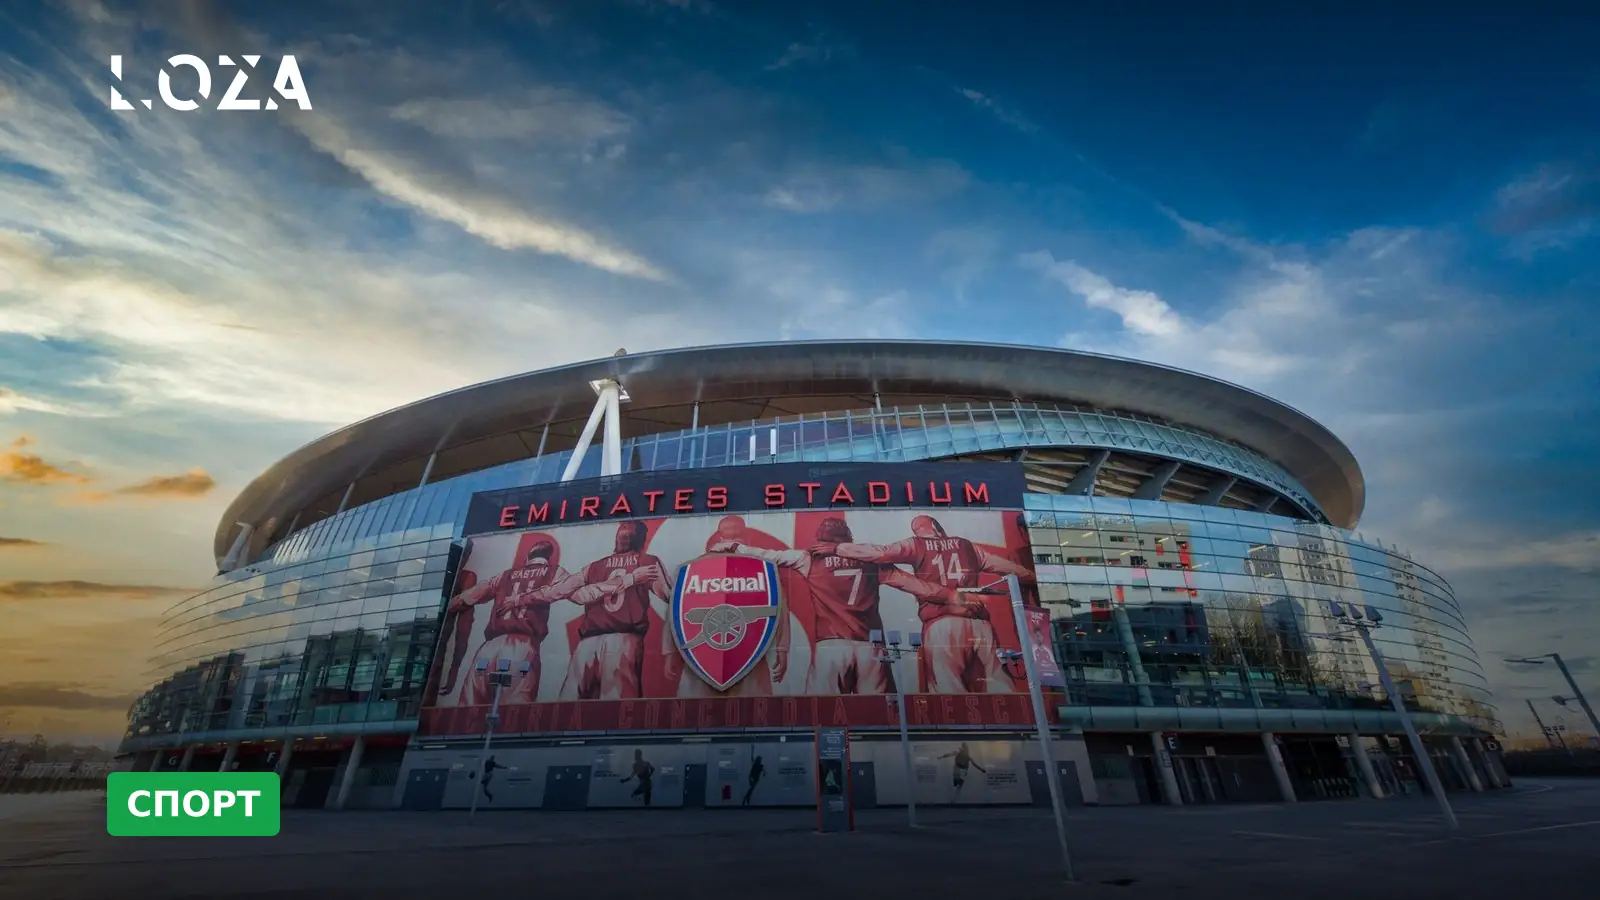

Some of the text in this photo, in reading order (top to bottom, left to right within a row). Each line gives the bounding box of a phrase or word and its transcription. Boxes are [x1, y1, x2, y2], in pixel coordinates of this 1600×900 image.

[500, 480, 990, 528] EMIRATES STADIUM
[925, 539, 960, 552] HENRY
[605, 555, 640, 569] ADAMS
[931, 553, 964, 586] 14
[511, 567, 549, 580] BASTIN
[685, 572, 765, 593] Arsenal
[833, 568, 862, 606] 7
[429, 701, 583, 734] VICORIA
[618, 697, 848, 729] CONCORDIA
[1168, 737, 1177, 749] E
